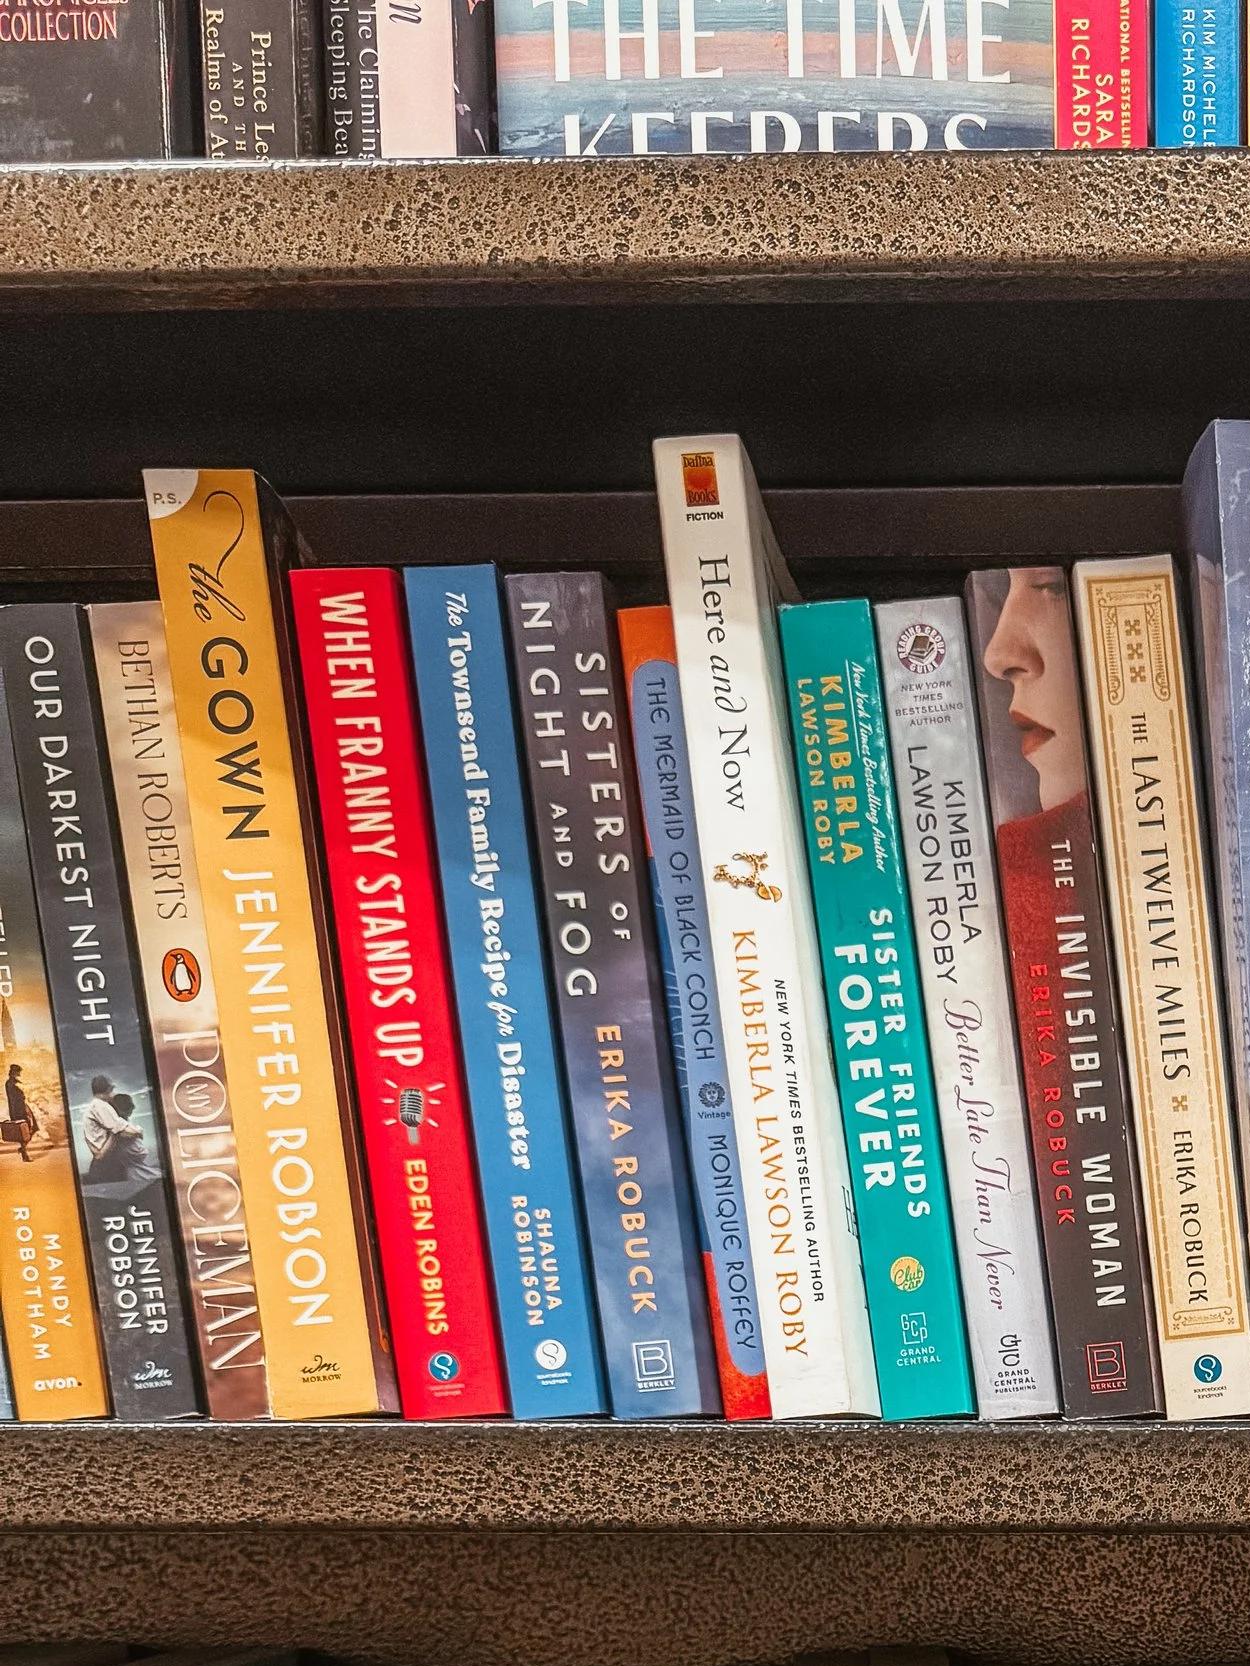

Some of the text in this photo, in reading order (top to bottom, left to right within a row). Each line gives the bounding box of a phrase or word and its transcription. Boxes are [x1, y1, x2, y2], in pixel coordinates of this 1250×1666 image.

[1095, 75, 1114, 144] SARA
[686, 510, 723, 522] FICTION
[189, 491, 270, 840] the GOWN
[698, 554, 750, 811] Here and Now
[24, 637, 115, 1045] OUR DARKEST NIGHT
[320, 592, 423, 1067] WHEN FRANNY STANDS UP
[222, 870, 334, 1326] JENNIFER ROBSON
[698, 1110, 730, 1120] Vintage
[14, 1207, 51, 1360] ROBOTHAM
[44, 1235, 71, 1328] MANDY
[105, 1218, 141, 1330] ROBSON
[131, 1206, 167, 1335] JENNIFER
[406, 1159, 448, 1335] EDEN ROBINS
[512, 1196, 544, 1326] ROBINSON
[534, 1208, 562, 1310] SHAUNA
